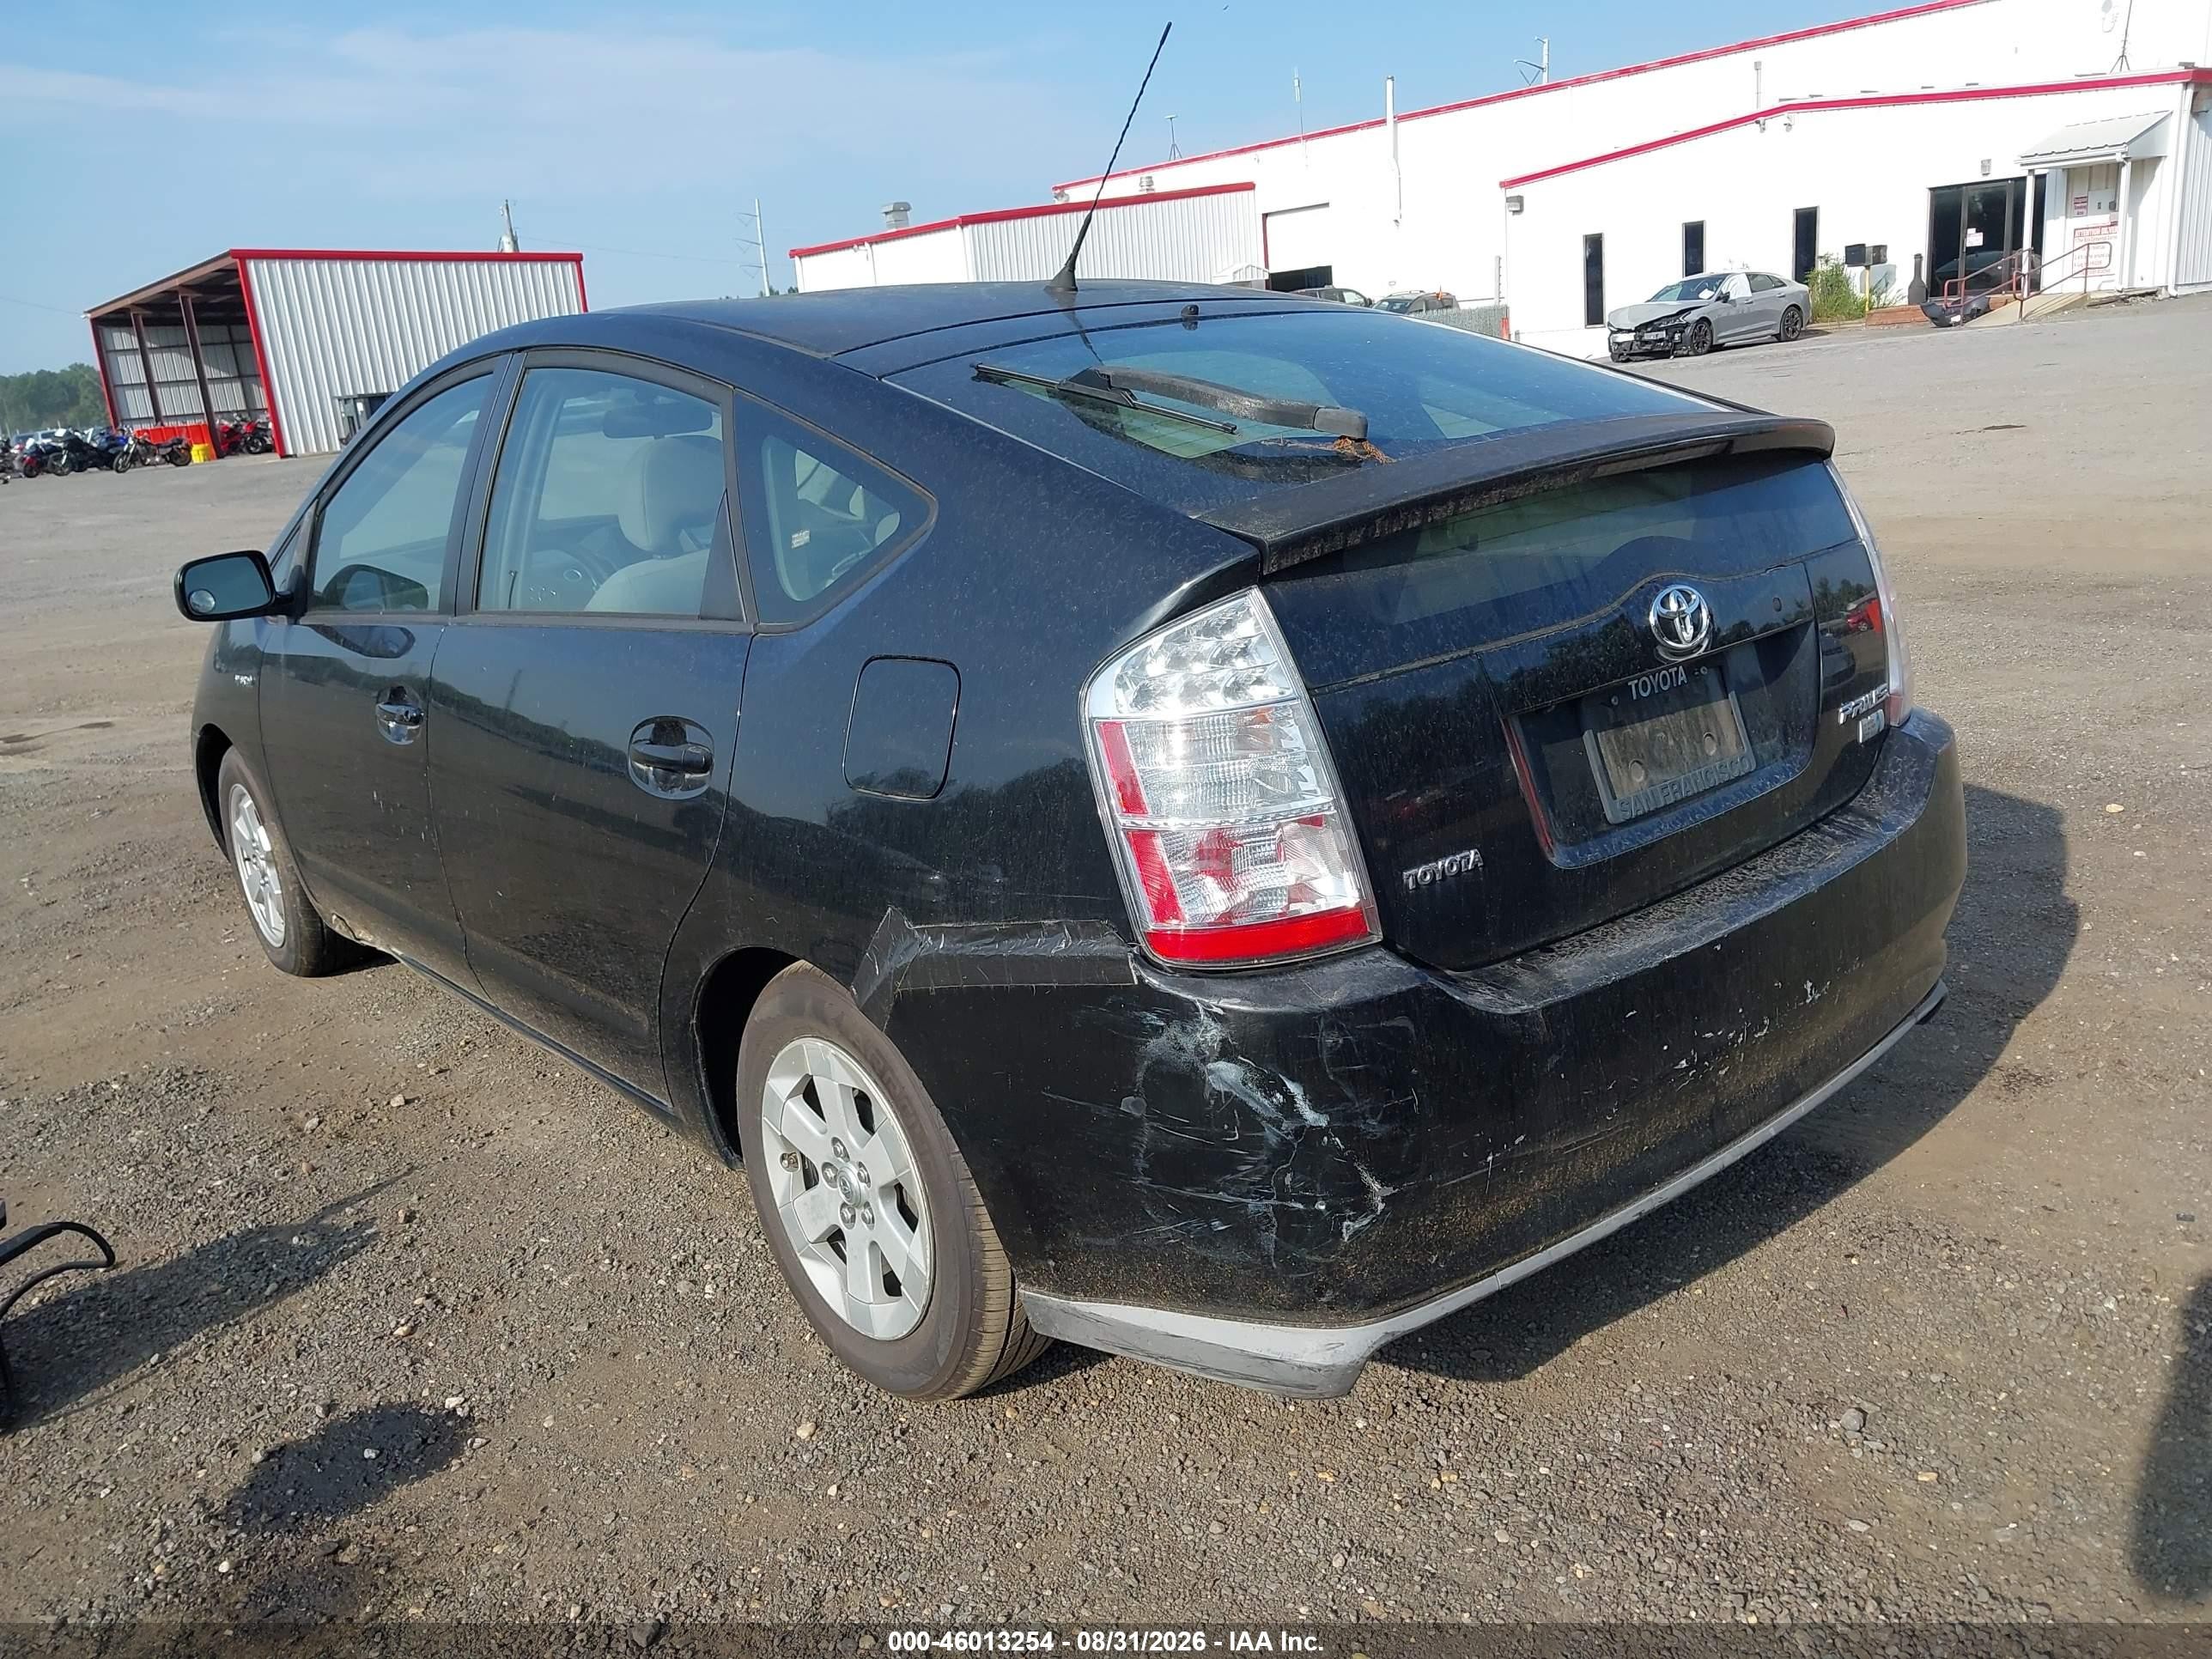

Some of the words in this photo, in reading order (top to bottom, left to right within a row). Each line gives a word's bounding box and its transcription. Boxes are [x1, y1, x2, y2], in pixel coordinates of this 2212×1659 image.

[1627, 665, 1688, 701] TOYOTA
[1618, 783, 1656, 819] SAN
[1658, 754, 1752, 807] FRANCISCO
[1401, 848, 1484, 890] TOYOTA
